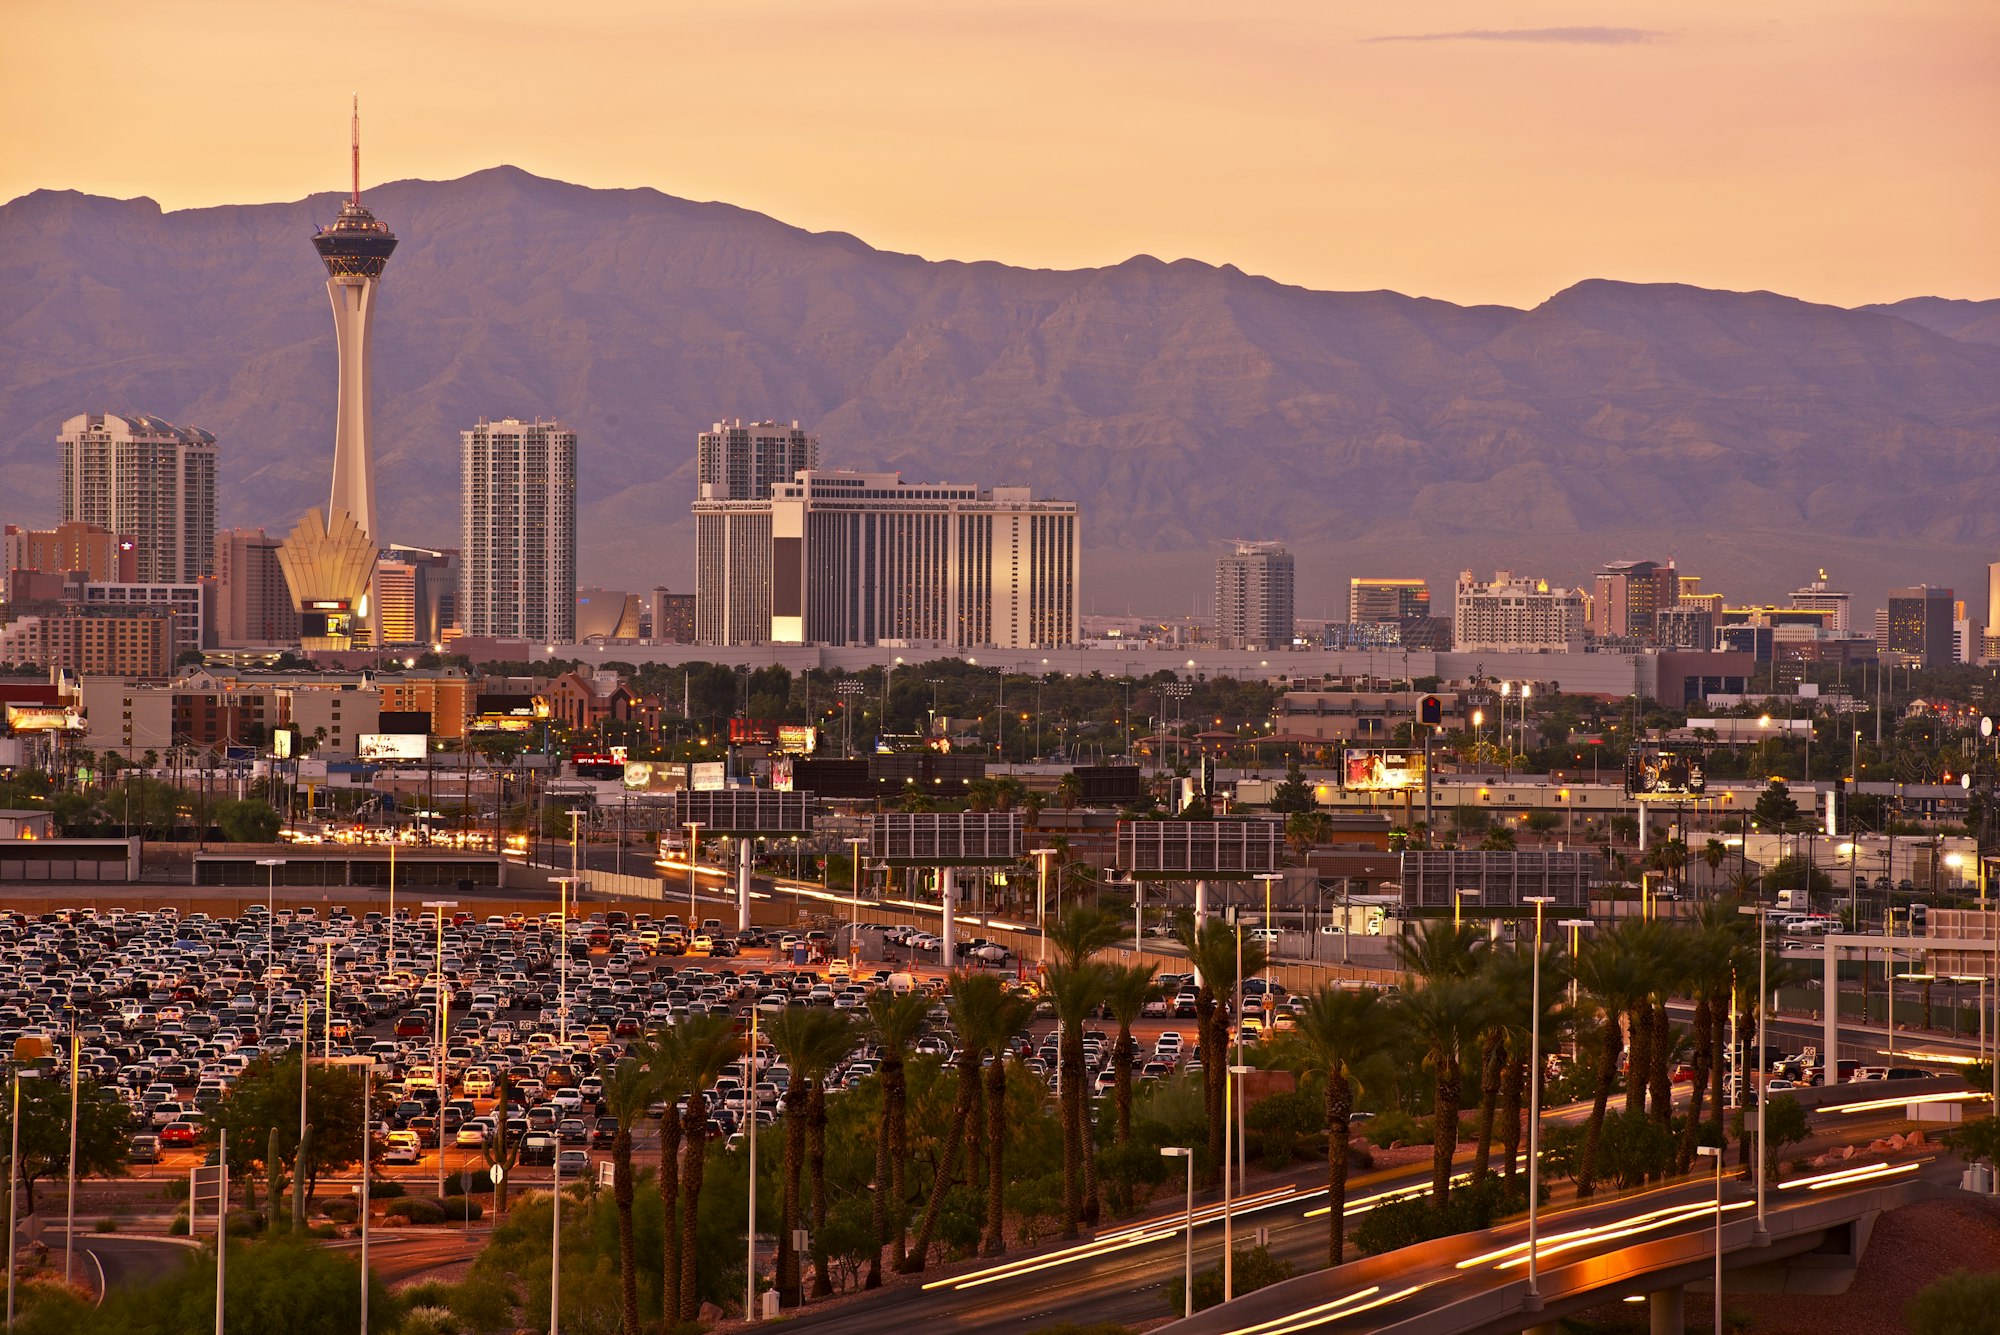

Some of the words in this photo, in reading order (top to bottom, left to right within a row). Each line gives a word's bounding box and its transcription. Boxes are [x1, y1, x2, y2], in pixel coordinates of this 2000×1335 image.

[17, 708, 40, 716] FREE
[41, 708, 75, 716] DRINKS
[559, 1008, 567, 1016] 2J
[521, 1021, 530, 1029] 2G
[500, 1033, 509, 1042] 2F
[432, 1047, 441, 1056] 2E
[1805, 1047, 1815, 1056] 2G
[407, 1056, 417, 1065] 2D
[1856, 1070, 1865, 1078] 2F
